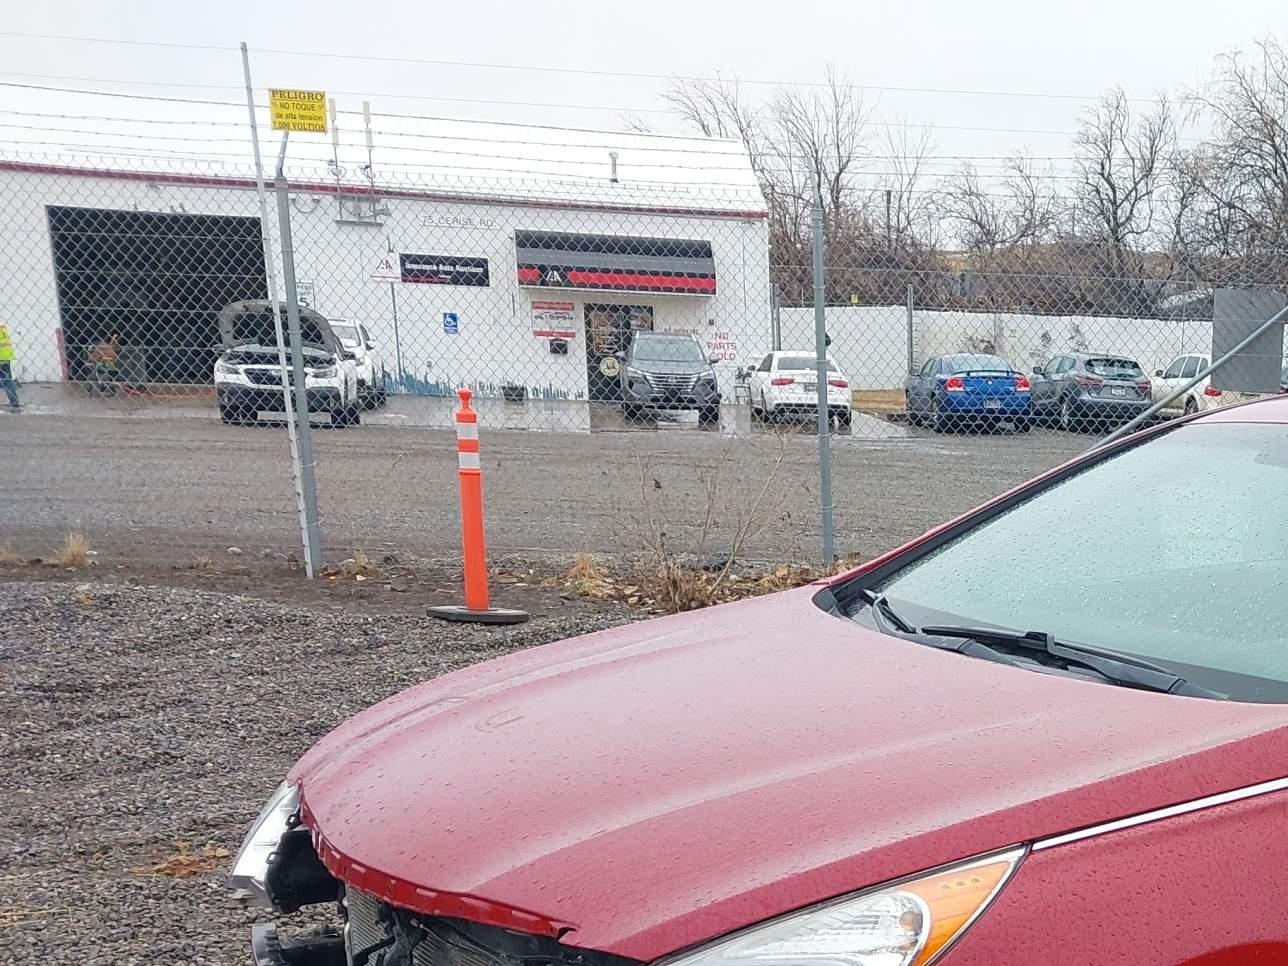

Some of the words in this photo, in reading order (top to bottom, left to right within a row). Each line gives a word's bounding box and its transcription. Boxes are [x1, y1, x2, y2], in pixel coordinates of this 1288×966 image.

[271, 89, 325, 101] PELIGRO
[279, 102, 290, 110] NO
[292, 103, 316, 112] TOQUE
[285, 112, 297, 120] alta
[292, 122, 326, 132] VOLTIOS
[439, 263, 455, 272] Auto
[456, 264, 485, 273] Auctions
[714, 331, 729, 340] NO
[707, 341, 738, 351] PARTS
[710, 352, 737, 361] OLD
